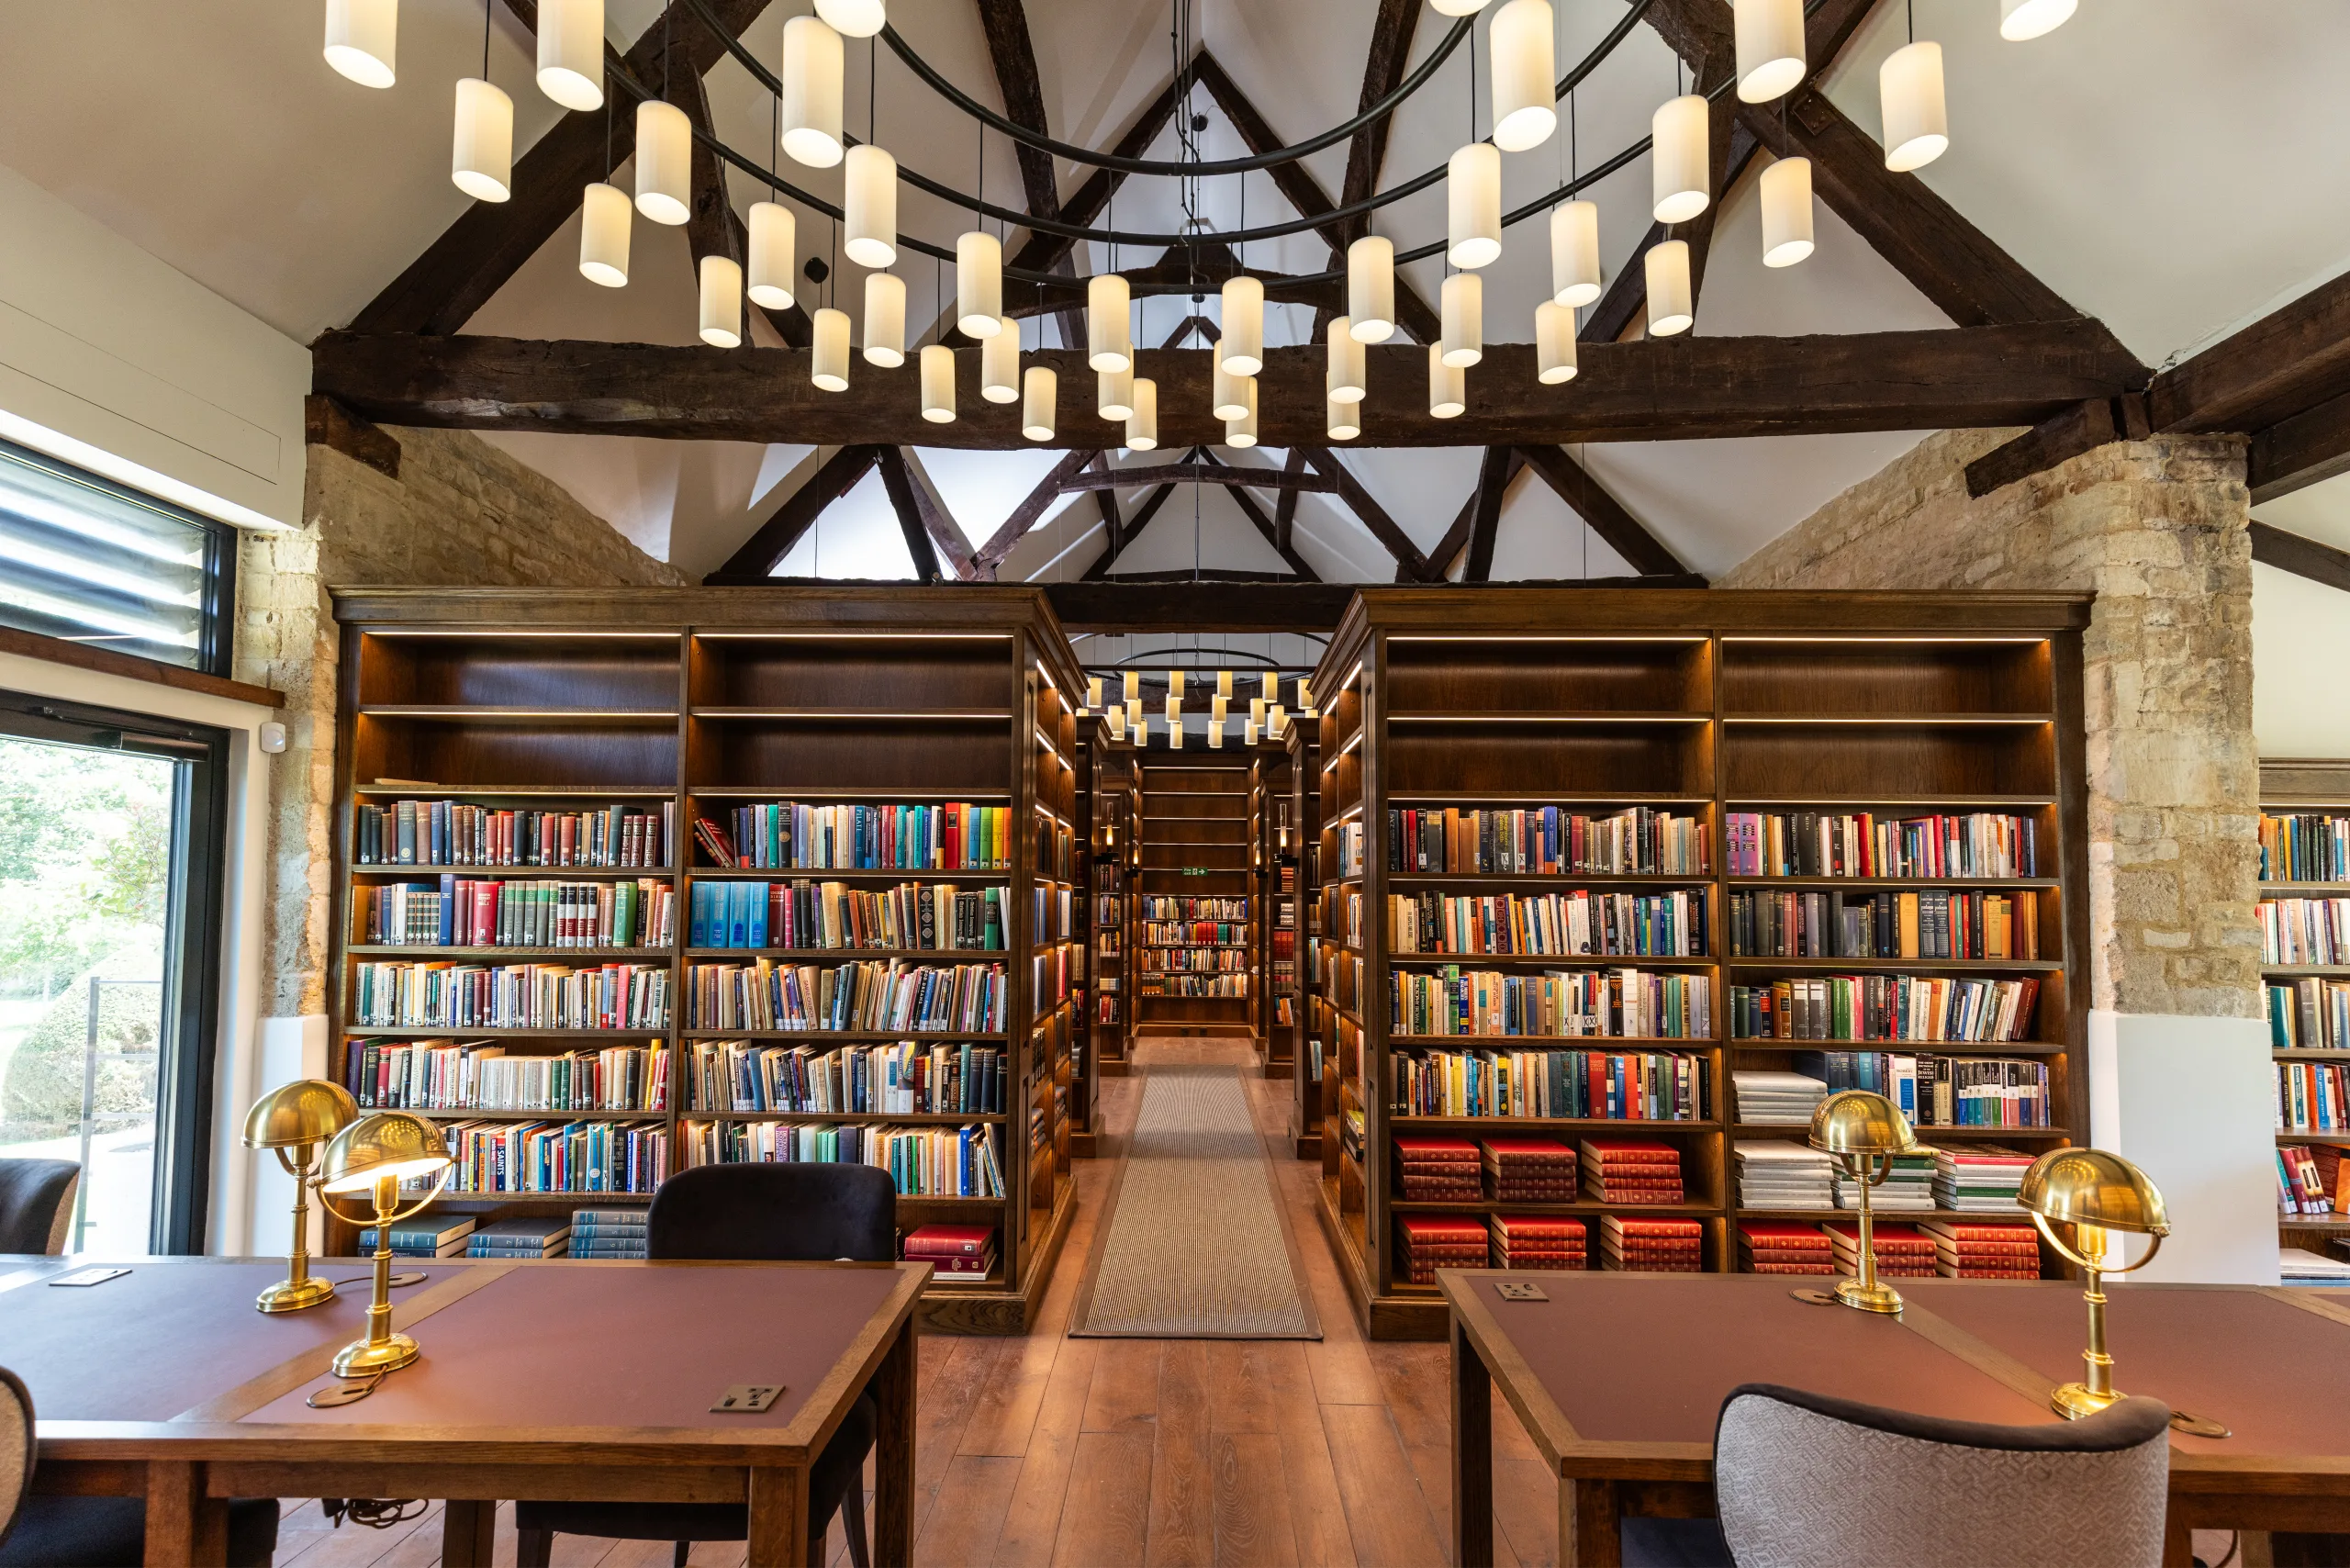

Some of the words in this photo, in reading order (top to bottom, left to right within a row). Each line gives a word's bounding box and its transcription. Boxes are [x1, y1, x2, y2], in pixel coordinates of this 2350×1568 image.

[918, 982, 926, 994] DREAMS
[806, 996, 814, 1017] CHURCH
[497, 1149, 505, 1175] SAINTS
